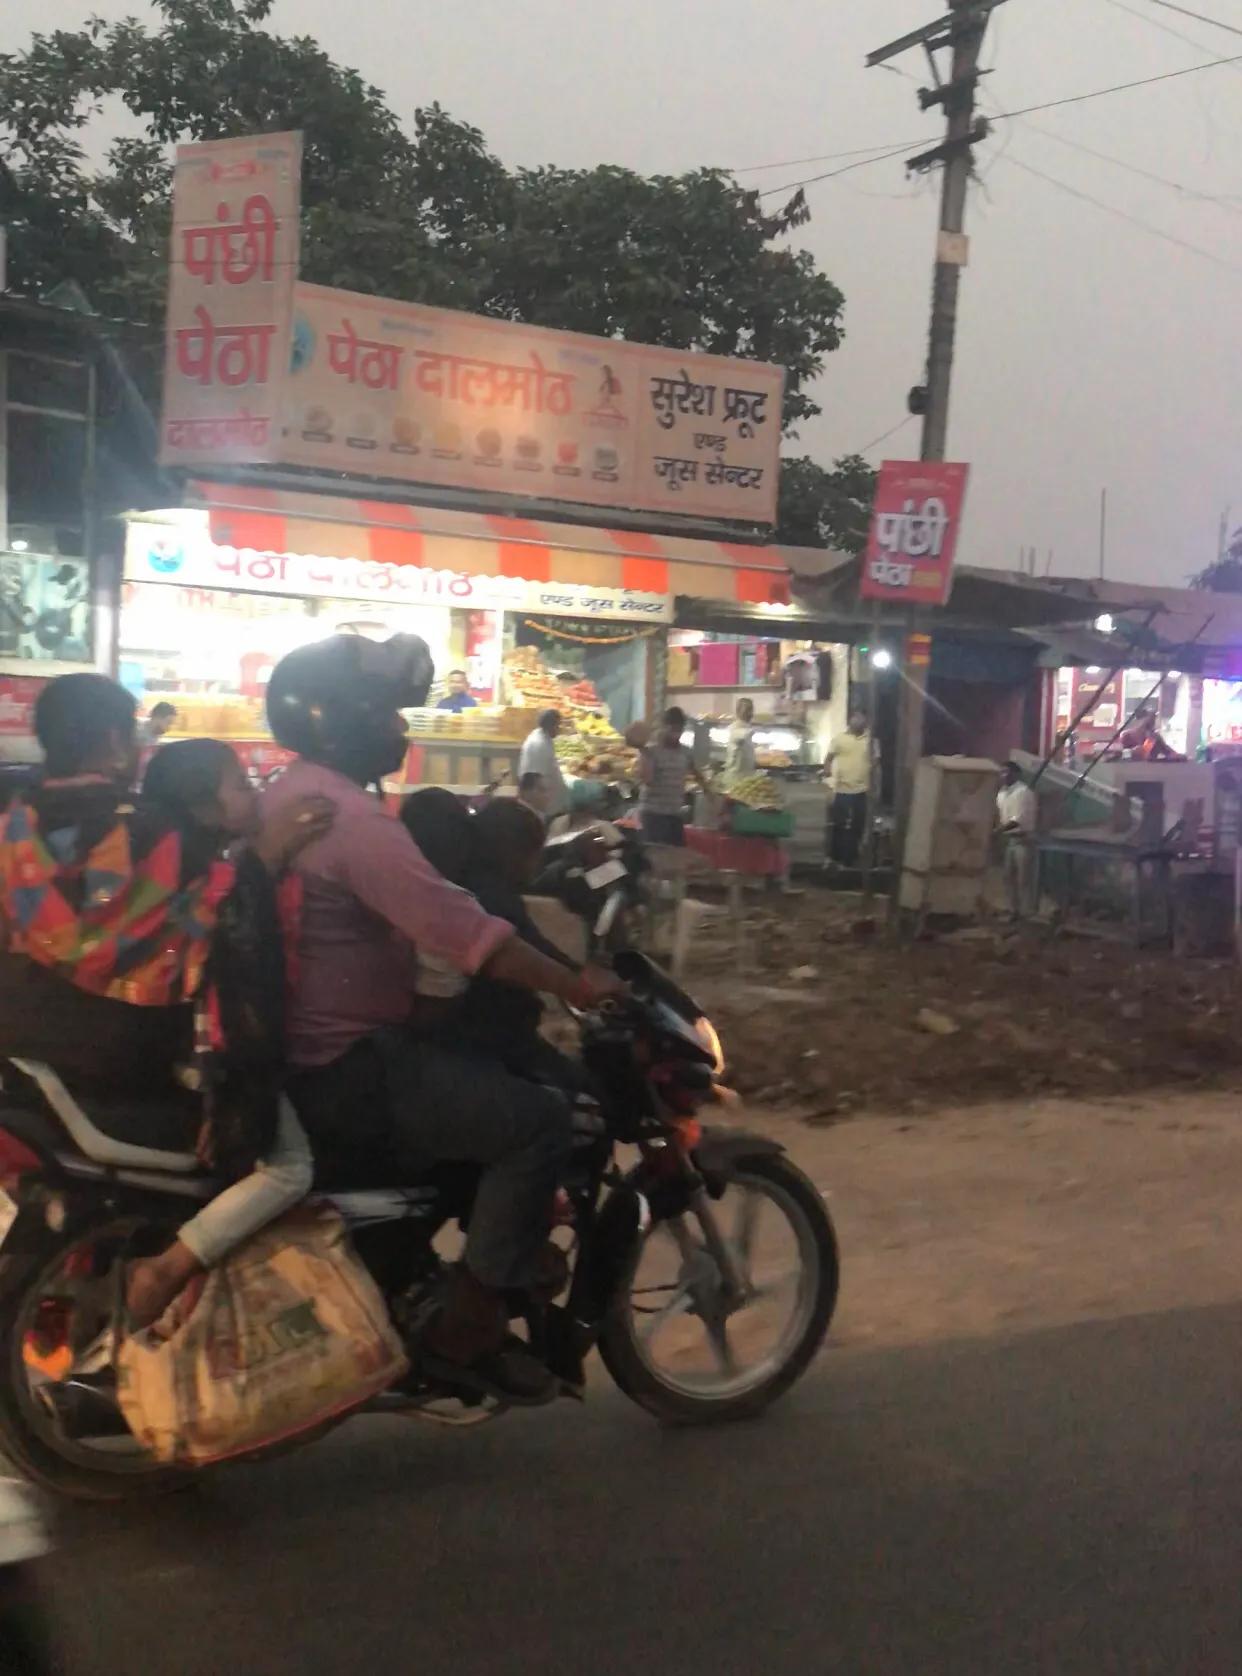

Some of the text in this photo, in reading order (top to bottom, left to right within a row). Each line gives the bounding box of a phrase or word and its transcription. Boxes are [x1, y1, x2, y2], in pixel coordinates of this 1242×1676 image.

[183, 194, 280, 285] पंछी
[176, 304, 276, 386] पेठा
[327, 318, 578, 416] पेठा दालमोठ
[650, 368, 716, 429] सुरेश
[653, 456, 699, 491] जूस
[876, 497, 948, 557] पंछी
